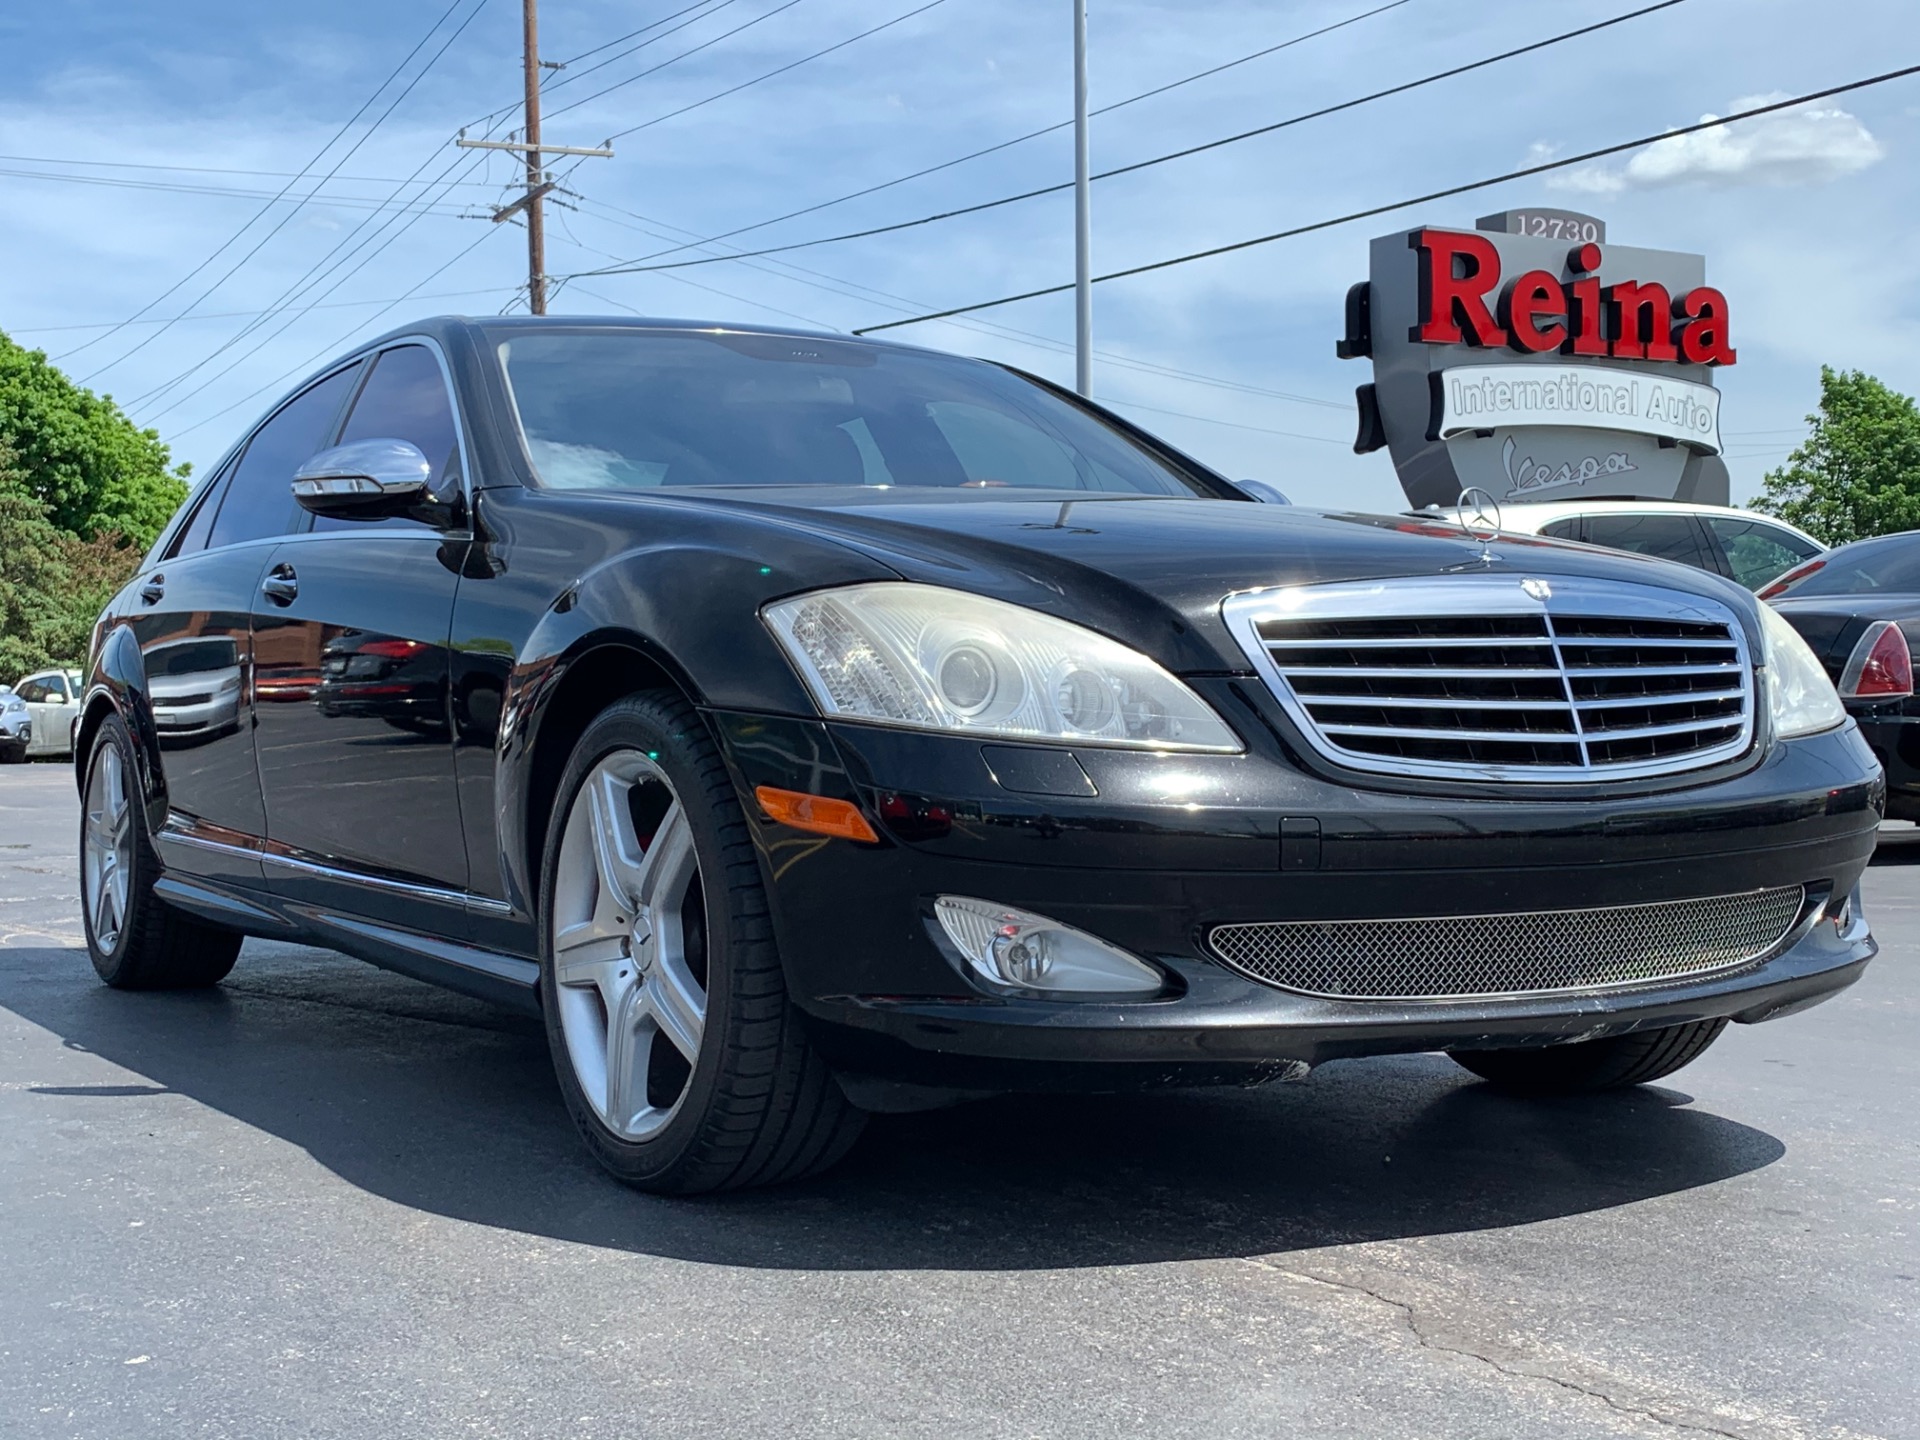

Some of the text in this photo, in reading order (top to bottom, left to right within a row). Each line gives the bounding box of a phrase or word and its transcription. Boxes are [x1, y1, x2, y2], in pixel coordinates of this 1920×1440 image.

[1517, 214, 1598, 243] 12730
[1418, 230, 1737, 366] Reina
[1451, 373, 1713, 434] International Auto
[1501, 434, 1639, 498] Vespa
